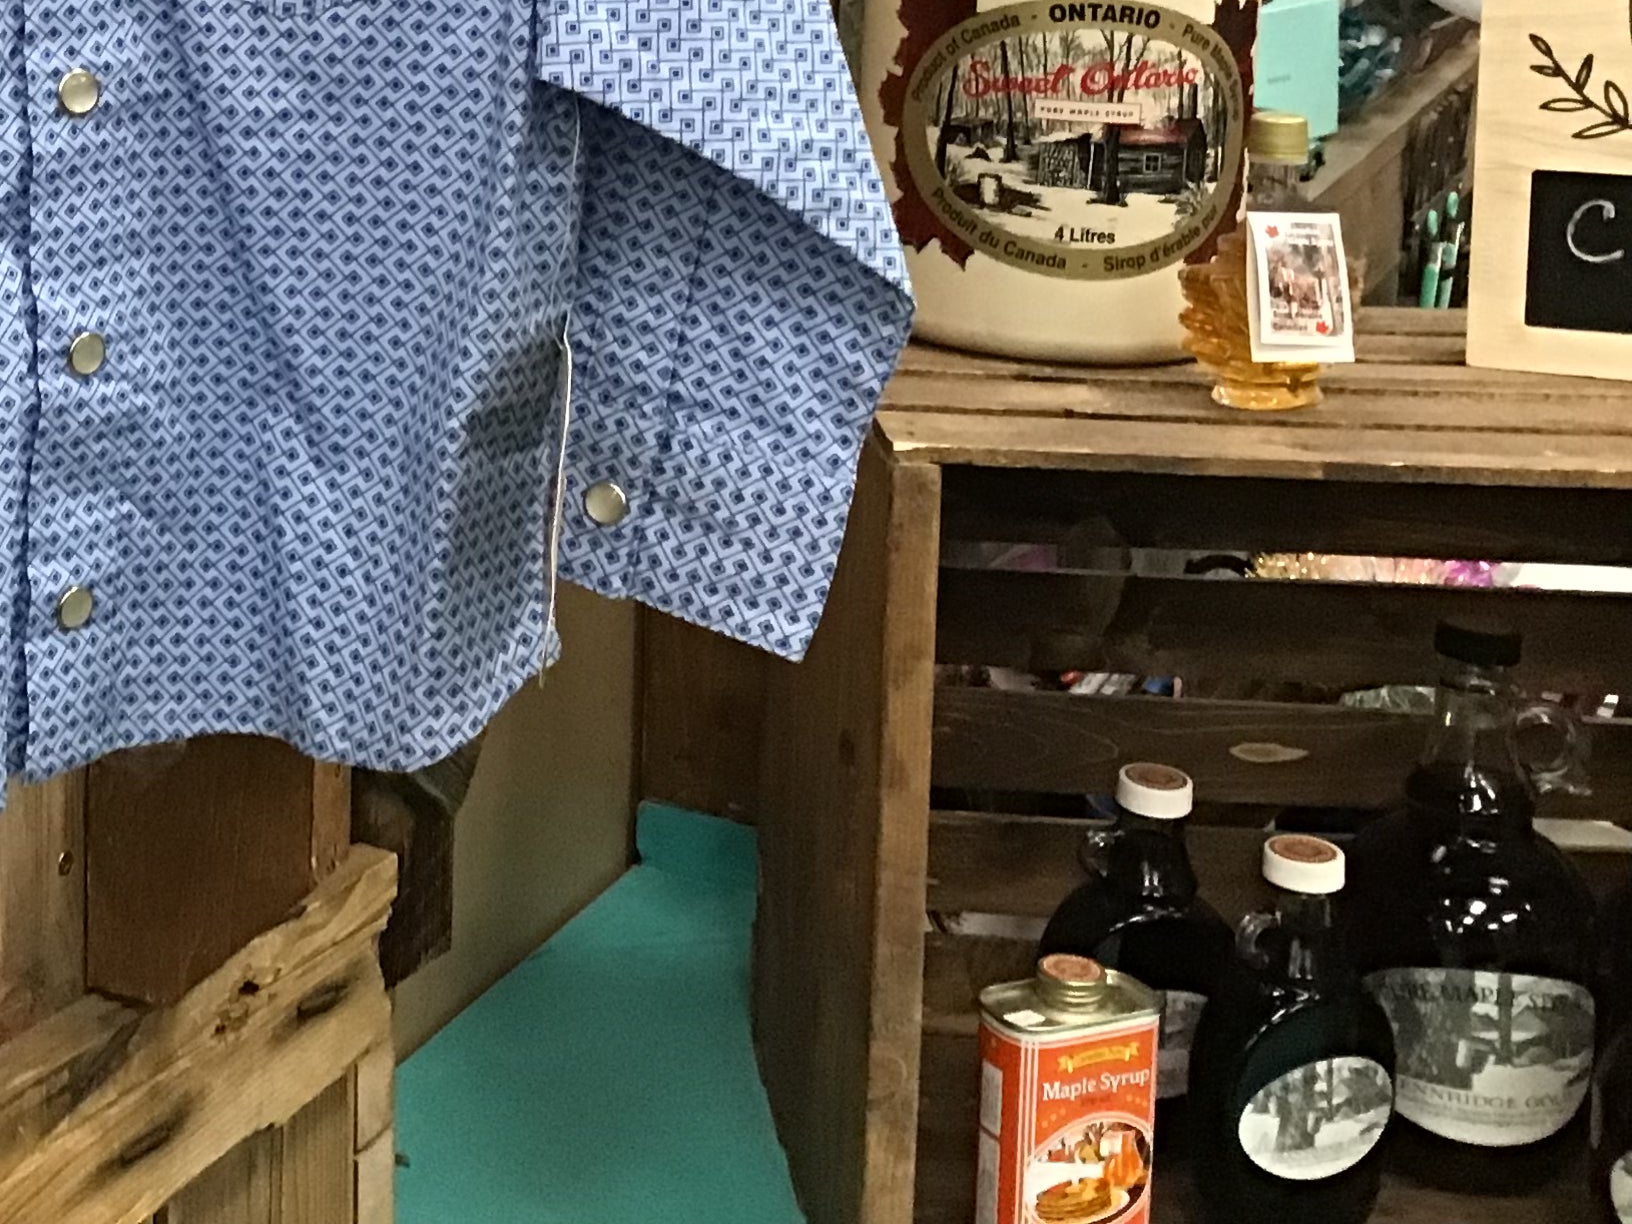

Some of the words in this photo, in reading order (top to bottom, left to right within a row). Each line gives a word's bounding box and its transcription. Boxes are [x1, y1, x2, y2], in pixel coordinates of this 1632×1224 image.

[945, 37, 961, 56] of
[960, 13, 1022, 45] Canada
[1048, 2, 1161, 30] ONTARIO
[1181, 23, 1211, 51] Pure
[962, 59, 1076, 99] Sweet
[1079, 59, 1199, 96] Ontario
[931, 186, 978, 236] Produit
[978, 229, 1001, 250] du
[1003, 239, 1067, 270] Canada
[1103, 253, 1147, 273] Sirop
[1054, 225, 1065, 243] 4
[1069, 226, 1116, 245] Litres
[1041, 1077, 1097, 1102] Maple
[1099, 1067, 1150, 1094] Syrup
